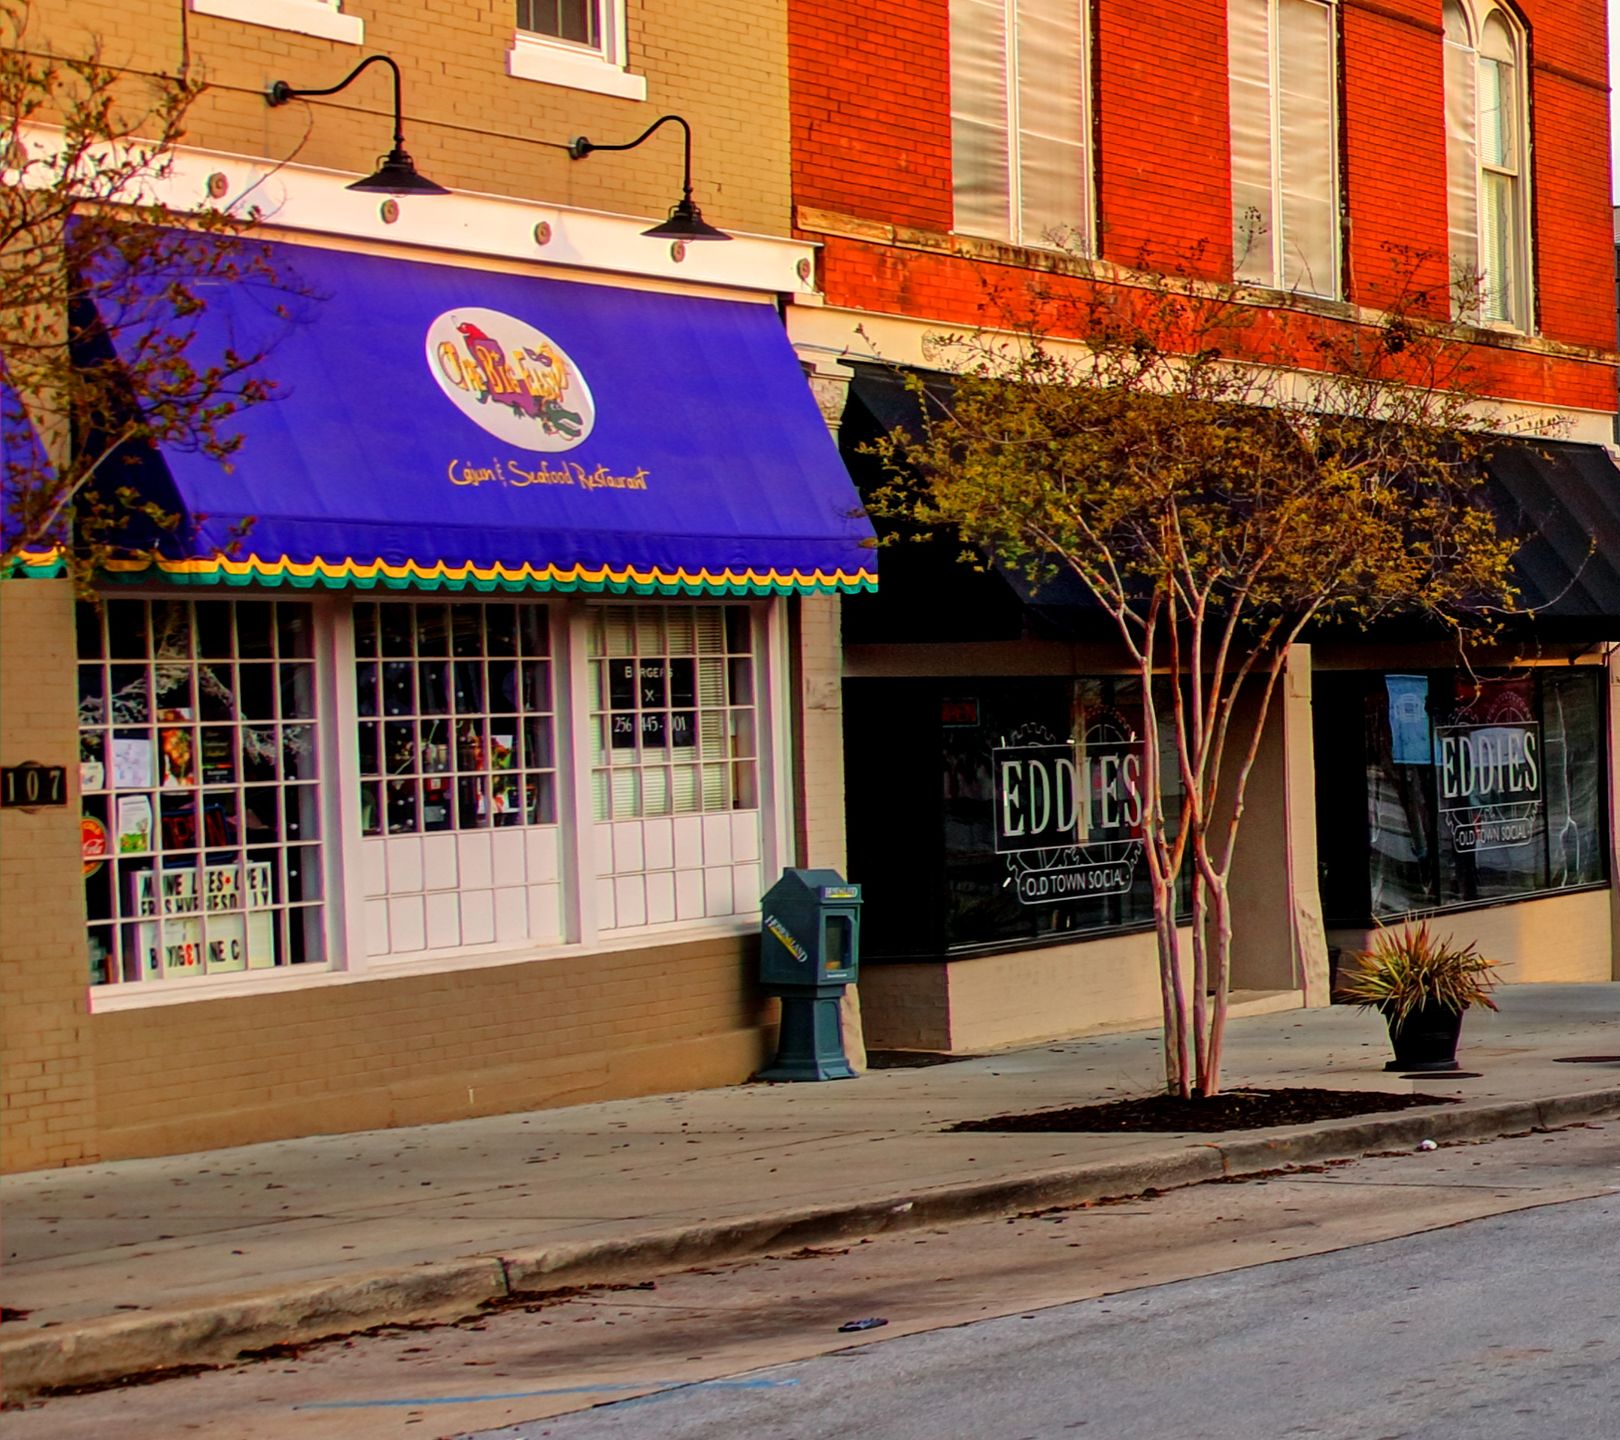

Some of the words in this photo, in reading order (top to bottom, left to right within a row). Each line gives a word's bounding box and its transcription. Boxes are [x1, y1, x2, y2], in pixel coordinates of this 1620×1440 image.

[448, 459, 496, 486] Cajun
[507, 460, 576, 488] Seafood
[571, 462, 651, 491] Restaurant
[1441, 731, 1538, 799] EDDIES
[5, 770, 62, 803] 107
[1000, 753, 1142, 838] EDDIES
[1458, 830, 1476, 847] OLD
[1476, 826, 1500, 844] TOWN
[1501, 822, 1528, 841] SOCIAL
[1050, 871, 1086, 894] TOWN
[1088, 866, 1126, 890] SOCIAL
